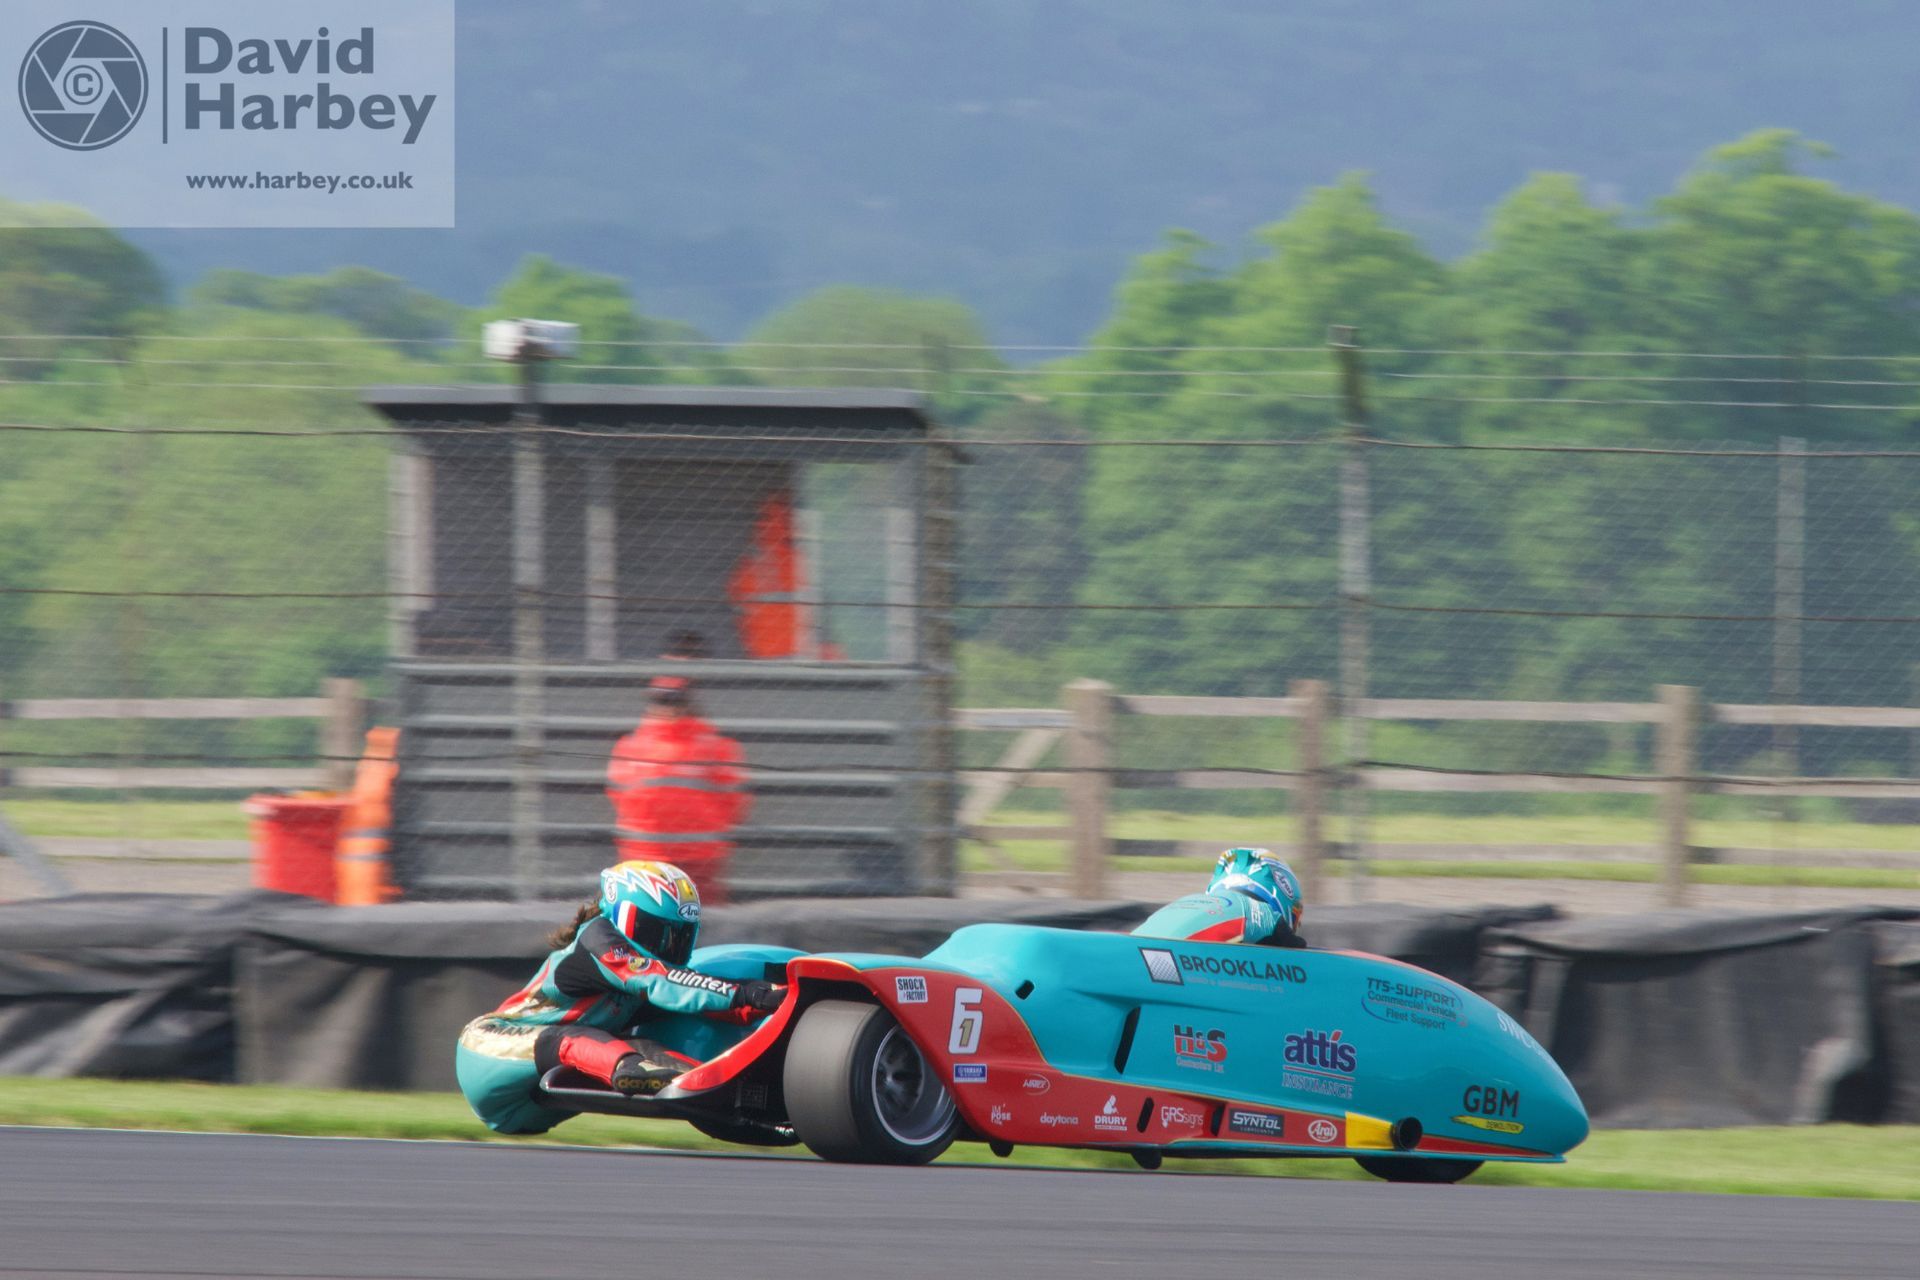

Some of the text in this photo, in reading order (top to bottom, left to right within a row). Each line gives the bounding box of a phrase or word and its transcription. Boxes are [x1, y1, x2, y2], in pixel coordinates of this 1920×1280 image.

[1180, 955, 1307, 984] BROOKLAND
[667, 969, 733, 995] wintex
[897, 978, 925, 990] SHOCK
[906, 991, 926, 1001] FACTORY
[1367, 977, 1455, 1008] TTS-SUPPORT
[1367, 990, 1424, 1010] Commercial
[1411, 1013, 1446, 1031] Support
[1174, 1024, 1227, 1063] H&S
[1284, 1028, 1357, 1073] attis
[1281, 1072, 1353, 1099] INSURANCE
[1463, 1084, 1519, 1118] GBM
[1040, 1112, 1078, 1127] daytona
[1094, 1115, 1127, 1125] DRURY
[1233, 1112, 1281, 1129] SYNTOL
[1311, 1122, 1333, 1136] Arai
